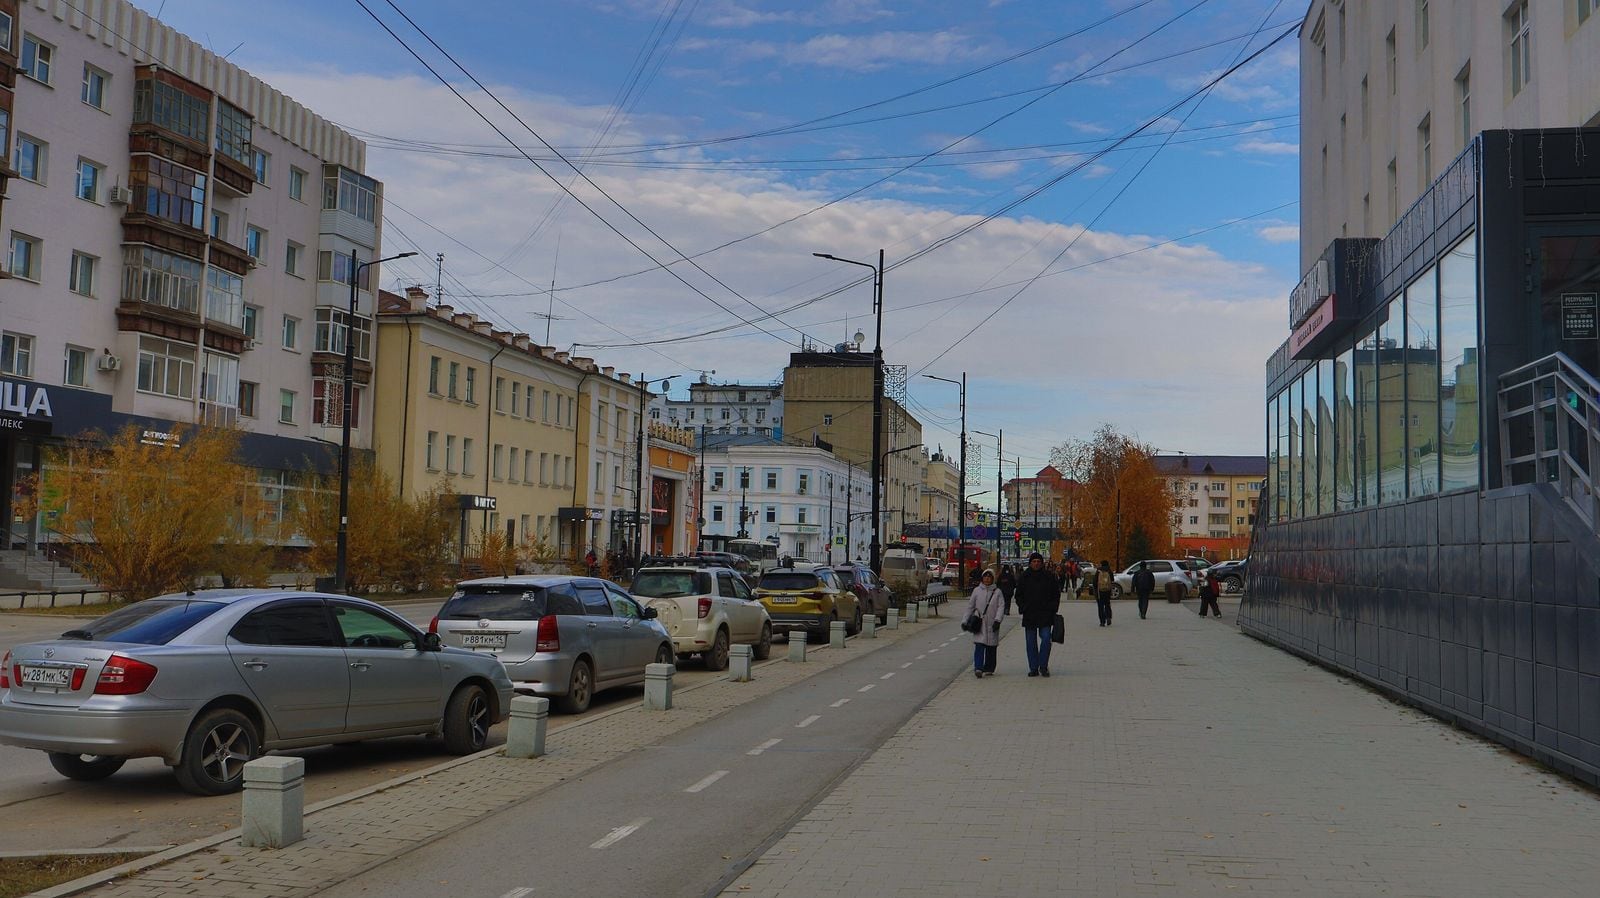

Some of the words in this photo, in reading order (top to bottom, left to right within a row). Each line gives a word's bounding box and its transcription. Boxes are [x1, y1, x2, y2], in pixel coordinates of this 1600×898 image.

[0, 418, 23, 429] ЛЕКС
[480, 497, 496, 508] МТС
[26, 669, 56, 682] У281МК
